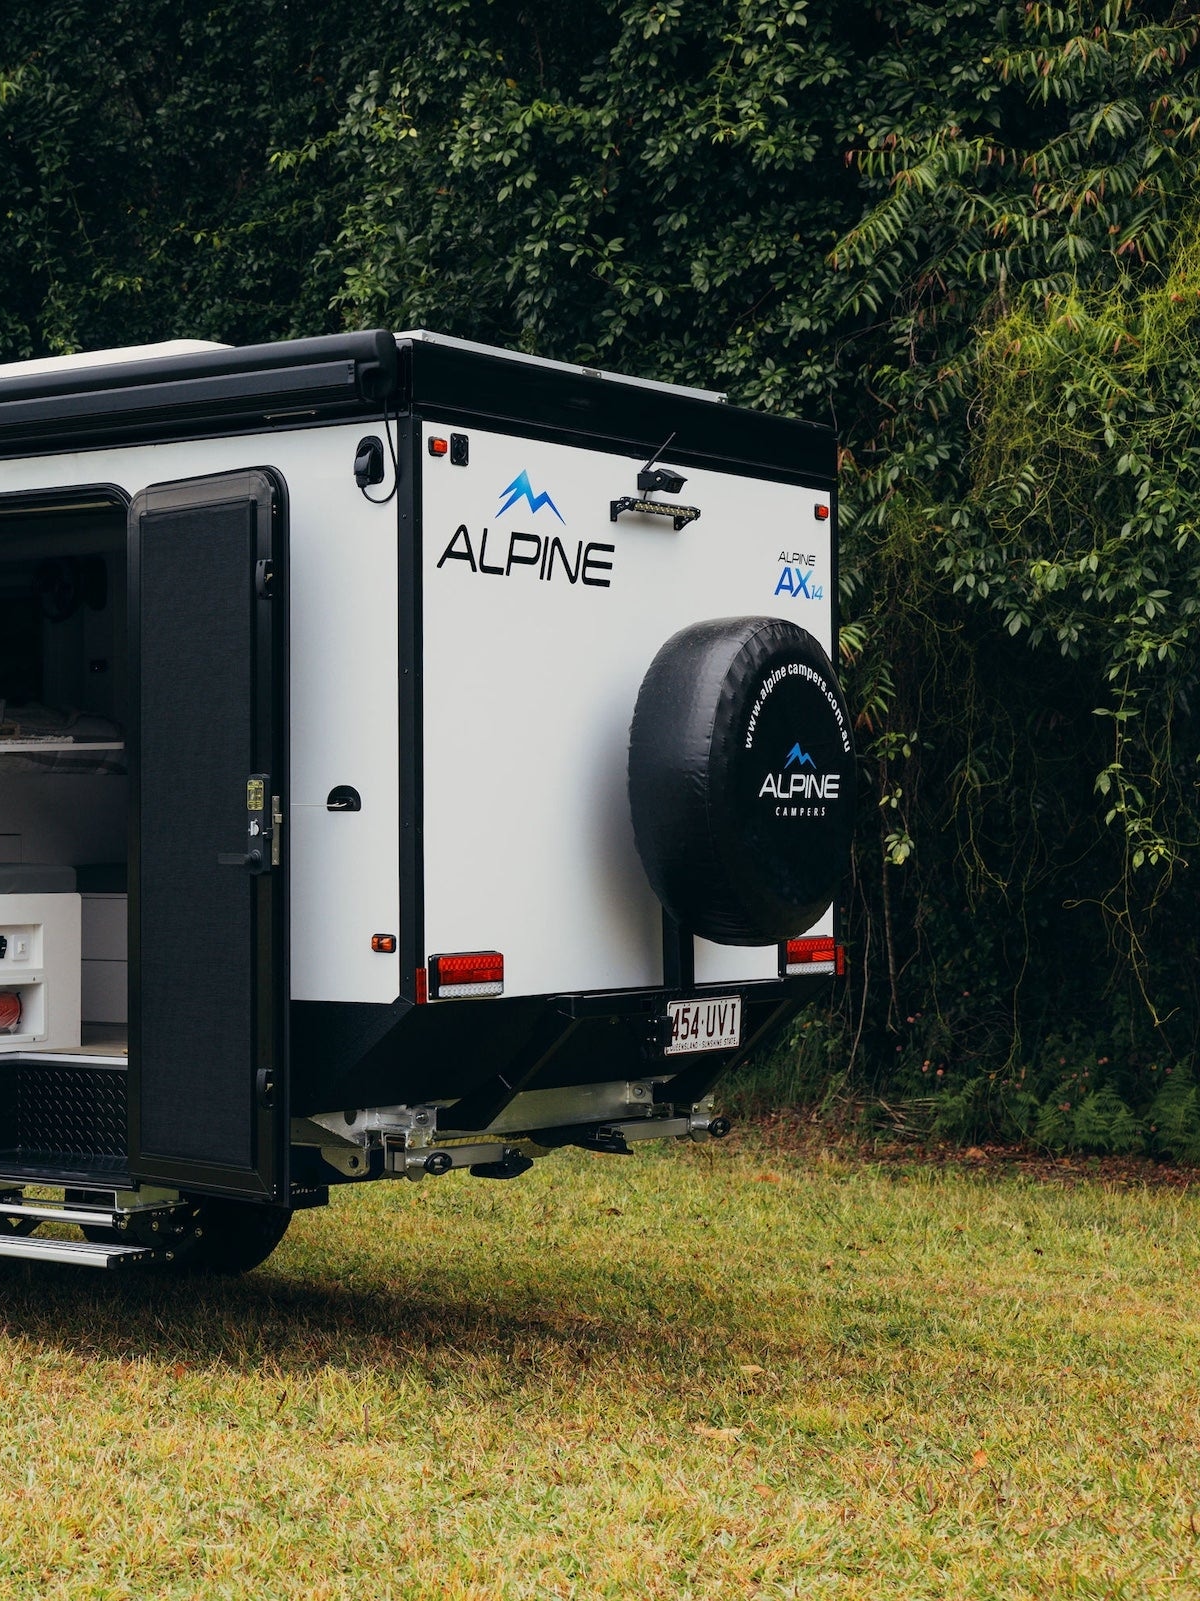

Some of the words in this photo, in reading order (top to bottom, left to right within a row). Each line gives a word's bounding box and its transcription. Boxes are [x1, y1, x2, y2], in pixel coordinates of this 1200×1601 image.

[437, 524, 615, 588] ALPINE
[777, 550, 816, 566] ALPINE
[758, 772, 841, 799] ALPINE
[775, 806, 826, 817] CAMPERS
